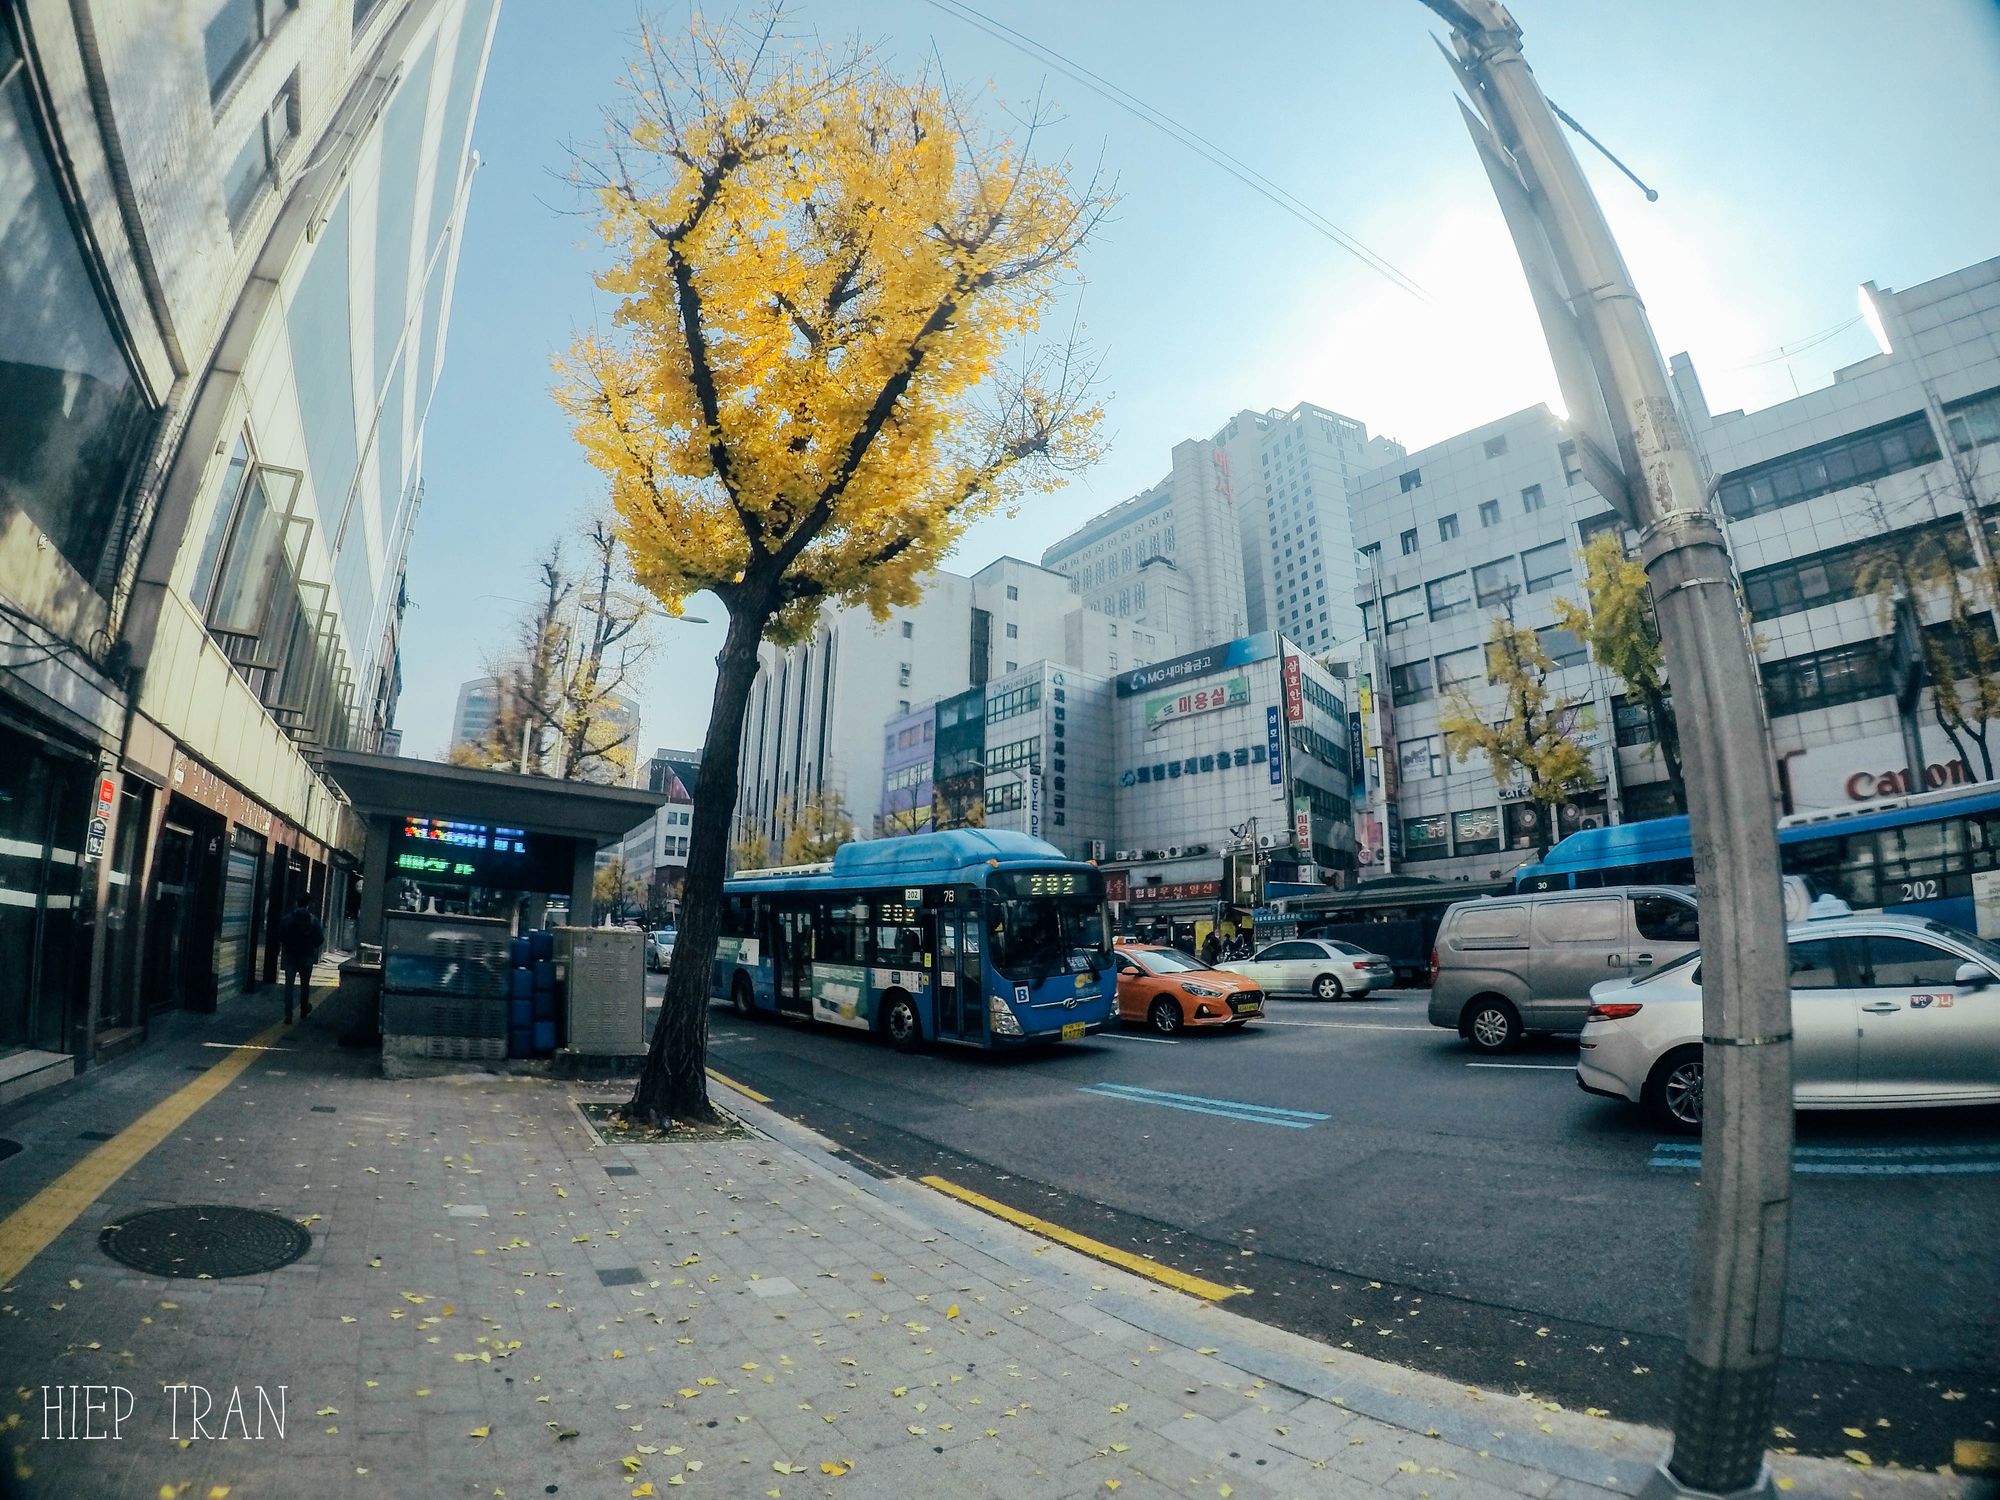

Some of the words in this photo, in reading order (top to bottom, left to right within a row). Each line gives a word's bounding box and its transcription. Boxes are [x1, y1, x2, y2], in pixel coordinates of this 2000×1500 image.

[1147, 656, 1212, 684] MG새마을금고
[1178, 687, 1225, 713] 미용실
[1287, 660, 1301, 717] 삼호안경
[1031, 778, 1039, 811] EYE
[1297, 814, 1310, 849] 미용실
[907, 890, 919, 899] 202
[943, 890, 955, 903] 78
[1031, 874, 1074, 895] 202
[1901, 879, 1938, 902] 202
[1017, 988, 1028, 1002] B
